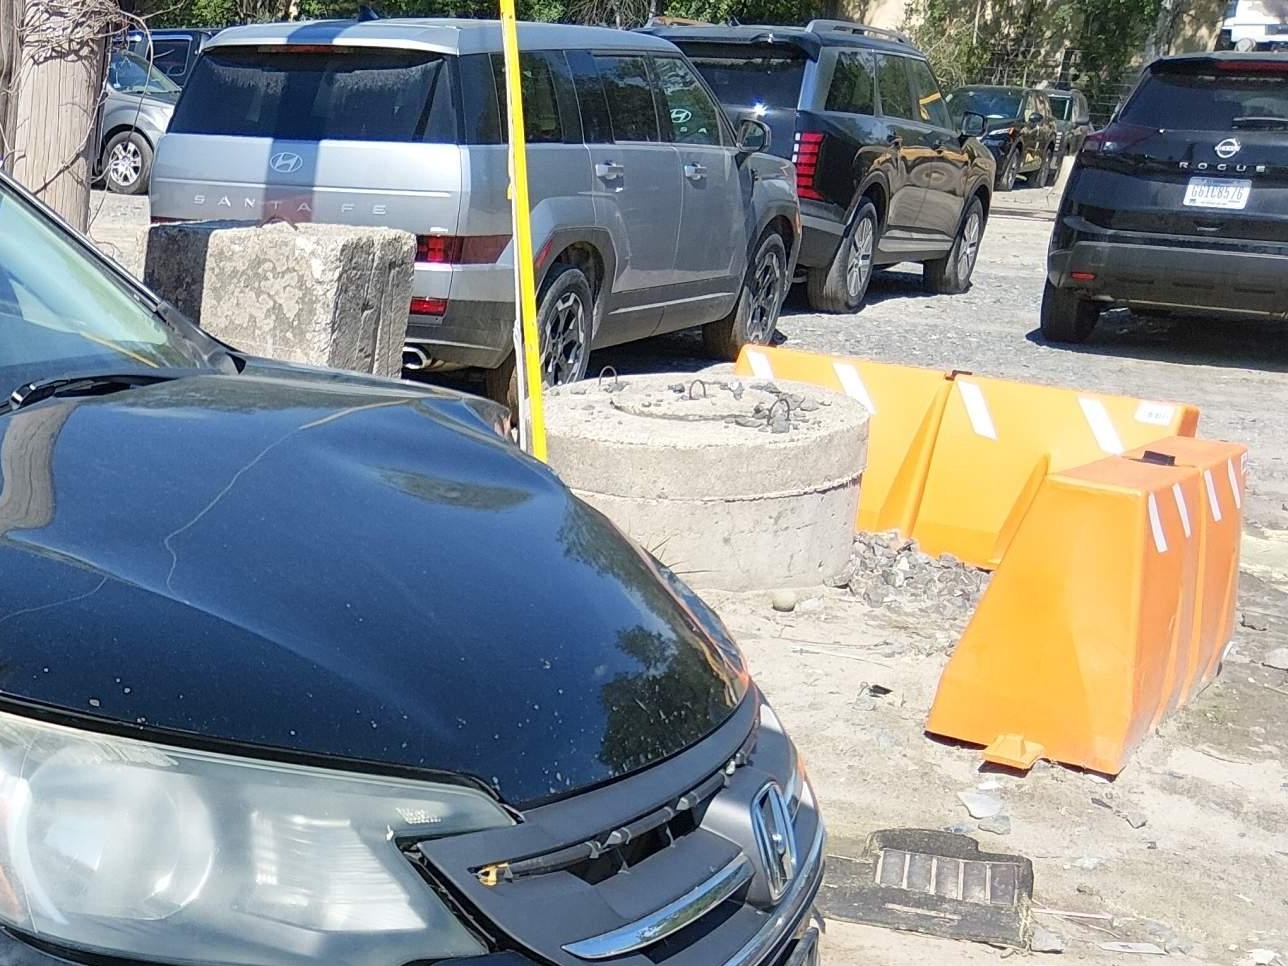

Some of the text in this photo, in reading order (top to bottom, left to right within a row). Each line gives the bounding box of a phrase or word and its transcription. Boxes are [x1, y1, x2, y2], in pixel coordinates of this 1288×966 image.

[1179, 162, 1266, 172] ROGUE
[195, 195, 387, 215] SANTA FE
